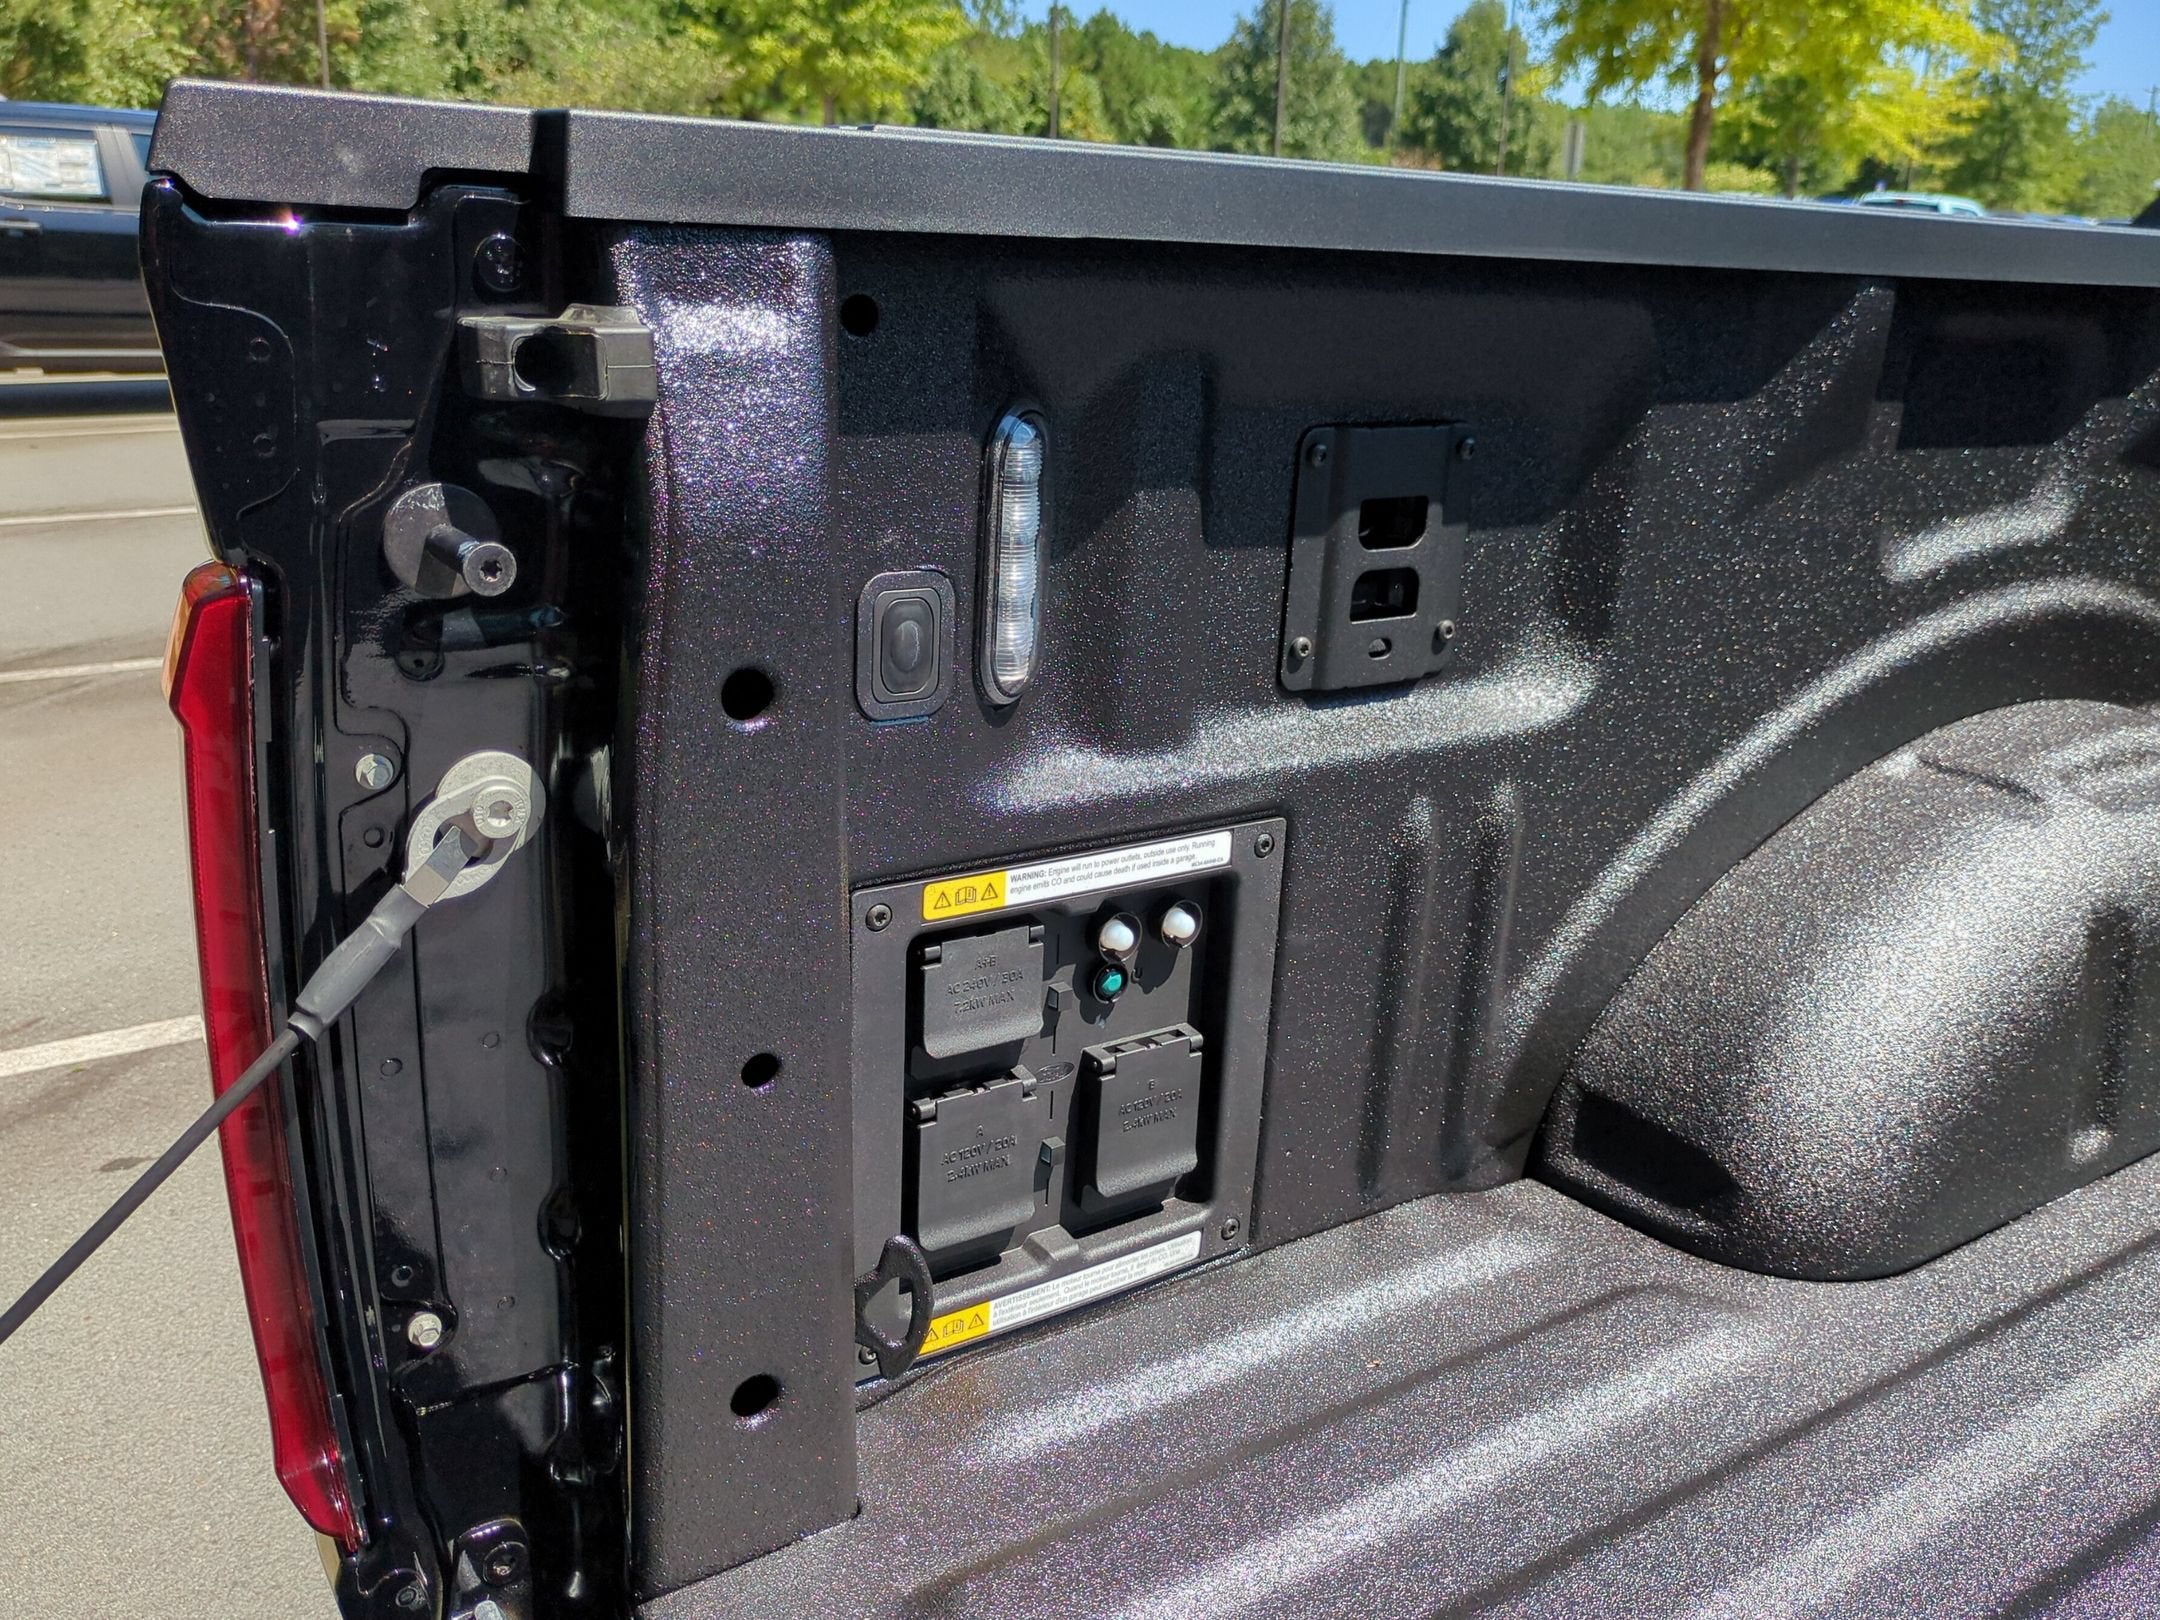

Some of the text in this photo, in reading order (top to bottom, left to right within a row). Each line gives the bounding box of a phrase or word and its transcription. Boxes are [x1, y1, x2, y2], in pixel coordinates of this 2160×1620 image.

[1010, 870, 1046, 882] WARNING:
[1048, 866, 1070, 878] Engine
[1071, 862, 1082, 871] will
[1082, 861, 1092, 869] run
[1101, 857, 1120, 869] power
[1144, 849, 1165, 859] outside
[1192, 839, 1215, 850] Running
[1010, 884, 1031, 895] engine
[1033, 880, 1050, 890] emits
[1051, 878, 1062, 887] CO
[1063, 875, 1075, 885] and
[1076, 871, 1093, 881] could
[1094, 869, 1112, 879] cause
[1113, 865, 1131, 875] death
[1137, 861, 1150, 871] used
